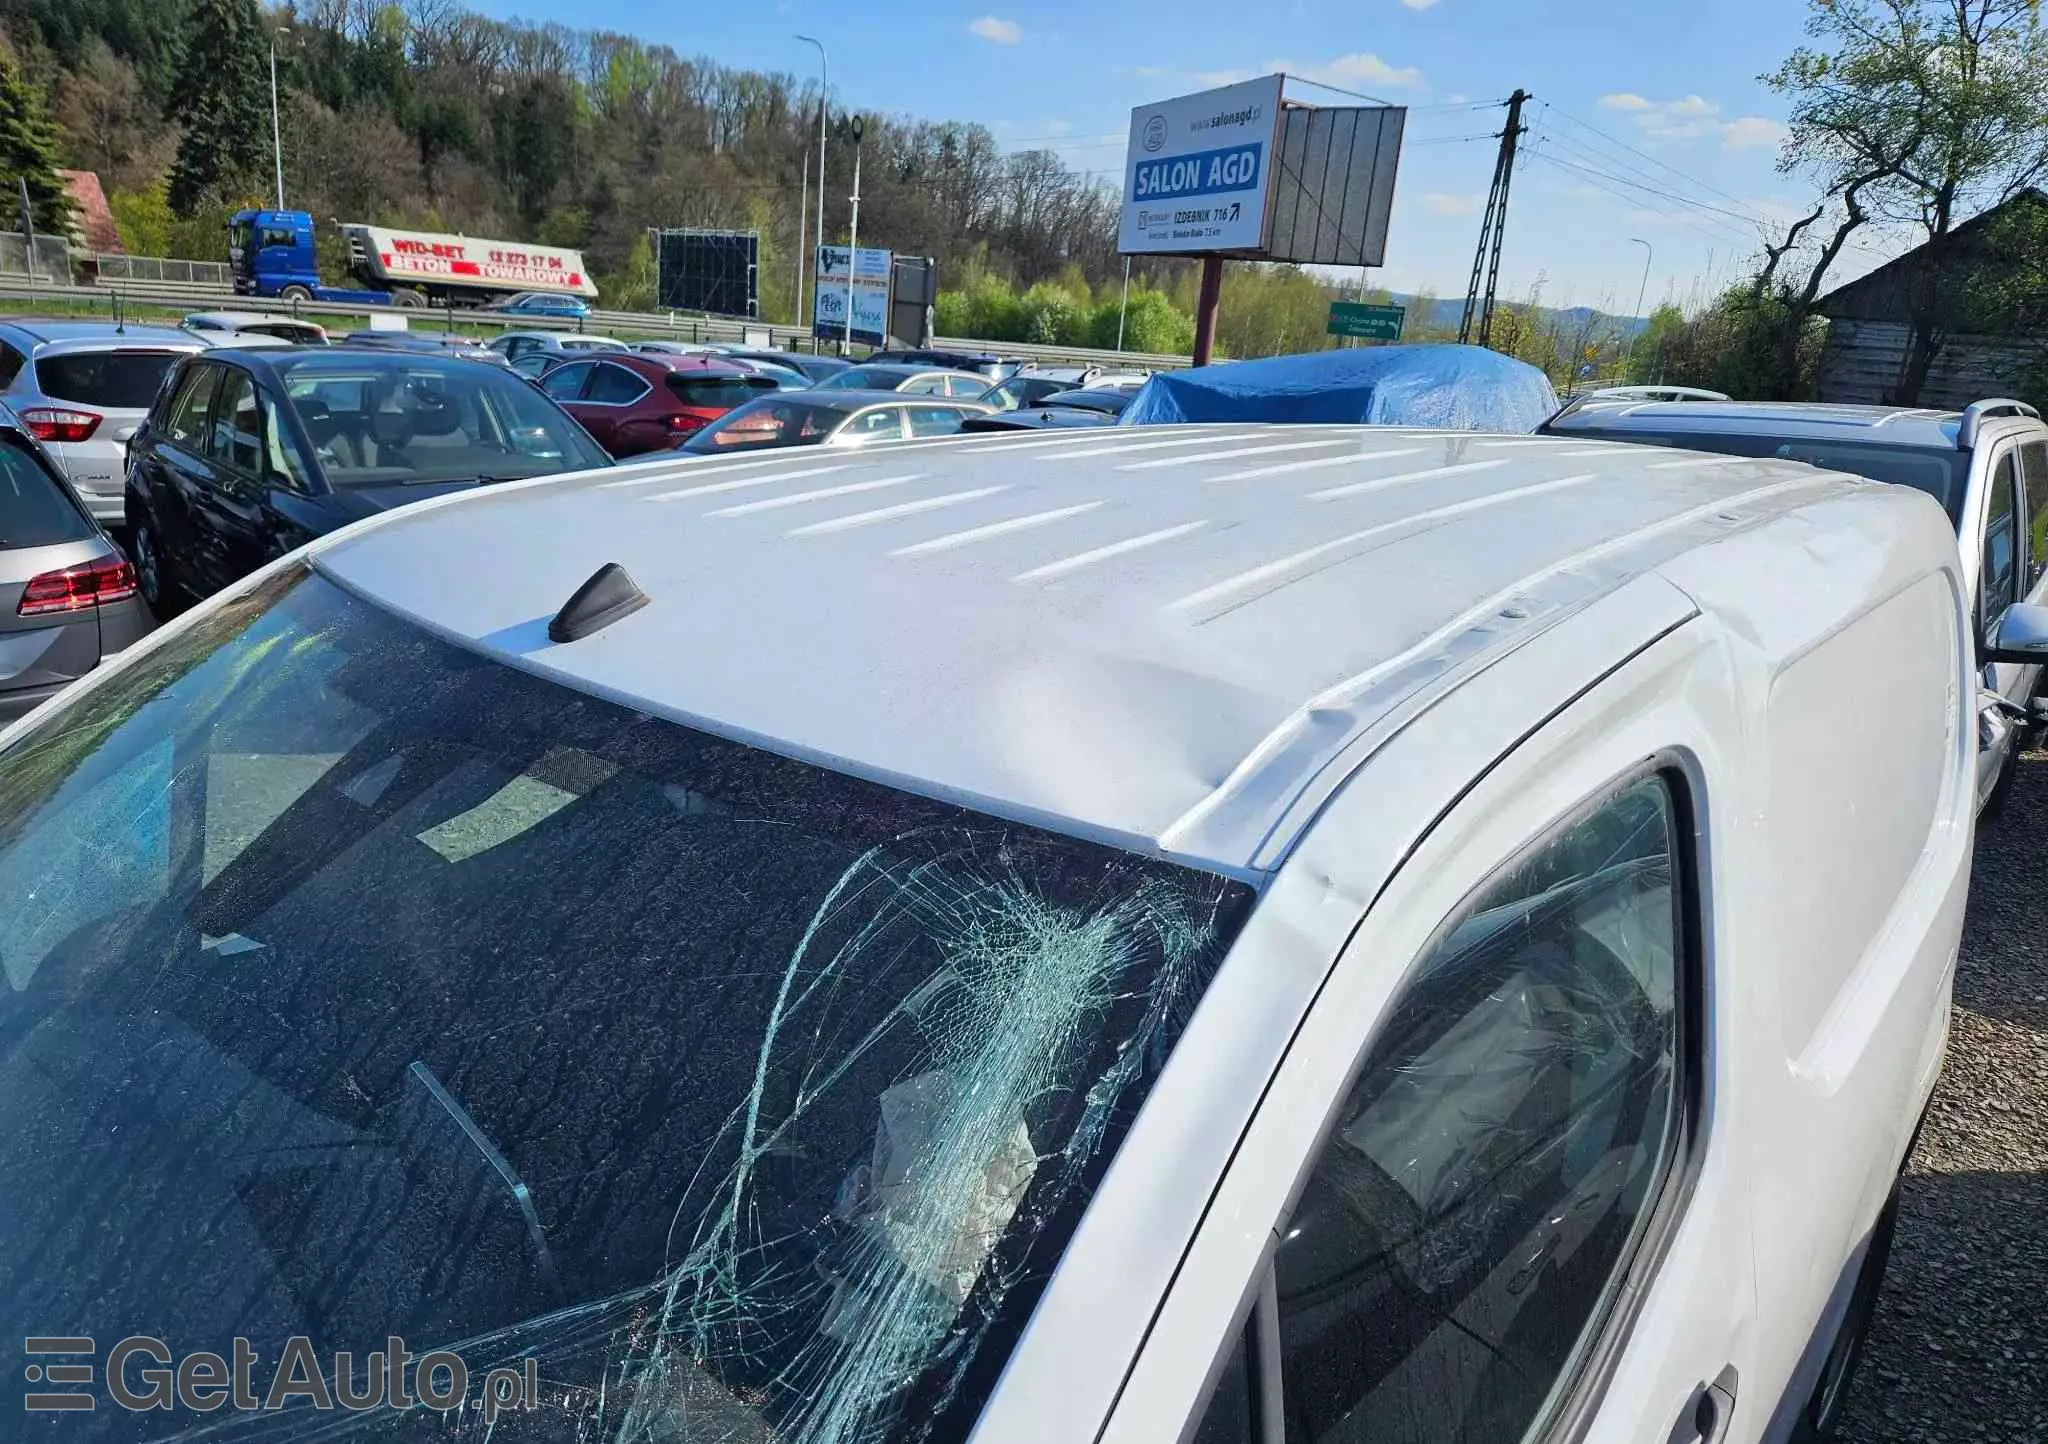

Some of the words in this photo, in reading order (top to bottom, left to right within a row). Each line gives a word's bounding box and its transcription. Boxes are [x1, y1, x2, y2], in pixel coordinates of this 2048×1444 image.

[1137, 161, 1200, 195] SALON
[1207, 151, 1255, 187] AGD
[1174, 209, 1210, 224] IZDEBNIK
[1213, 207, 1228, 221] 716
[392, 239, 464, 259] WID-BET
[391, 256, 451, 273] BETON
[480, 263, 571, 286] TOWAROWY
